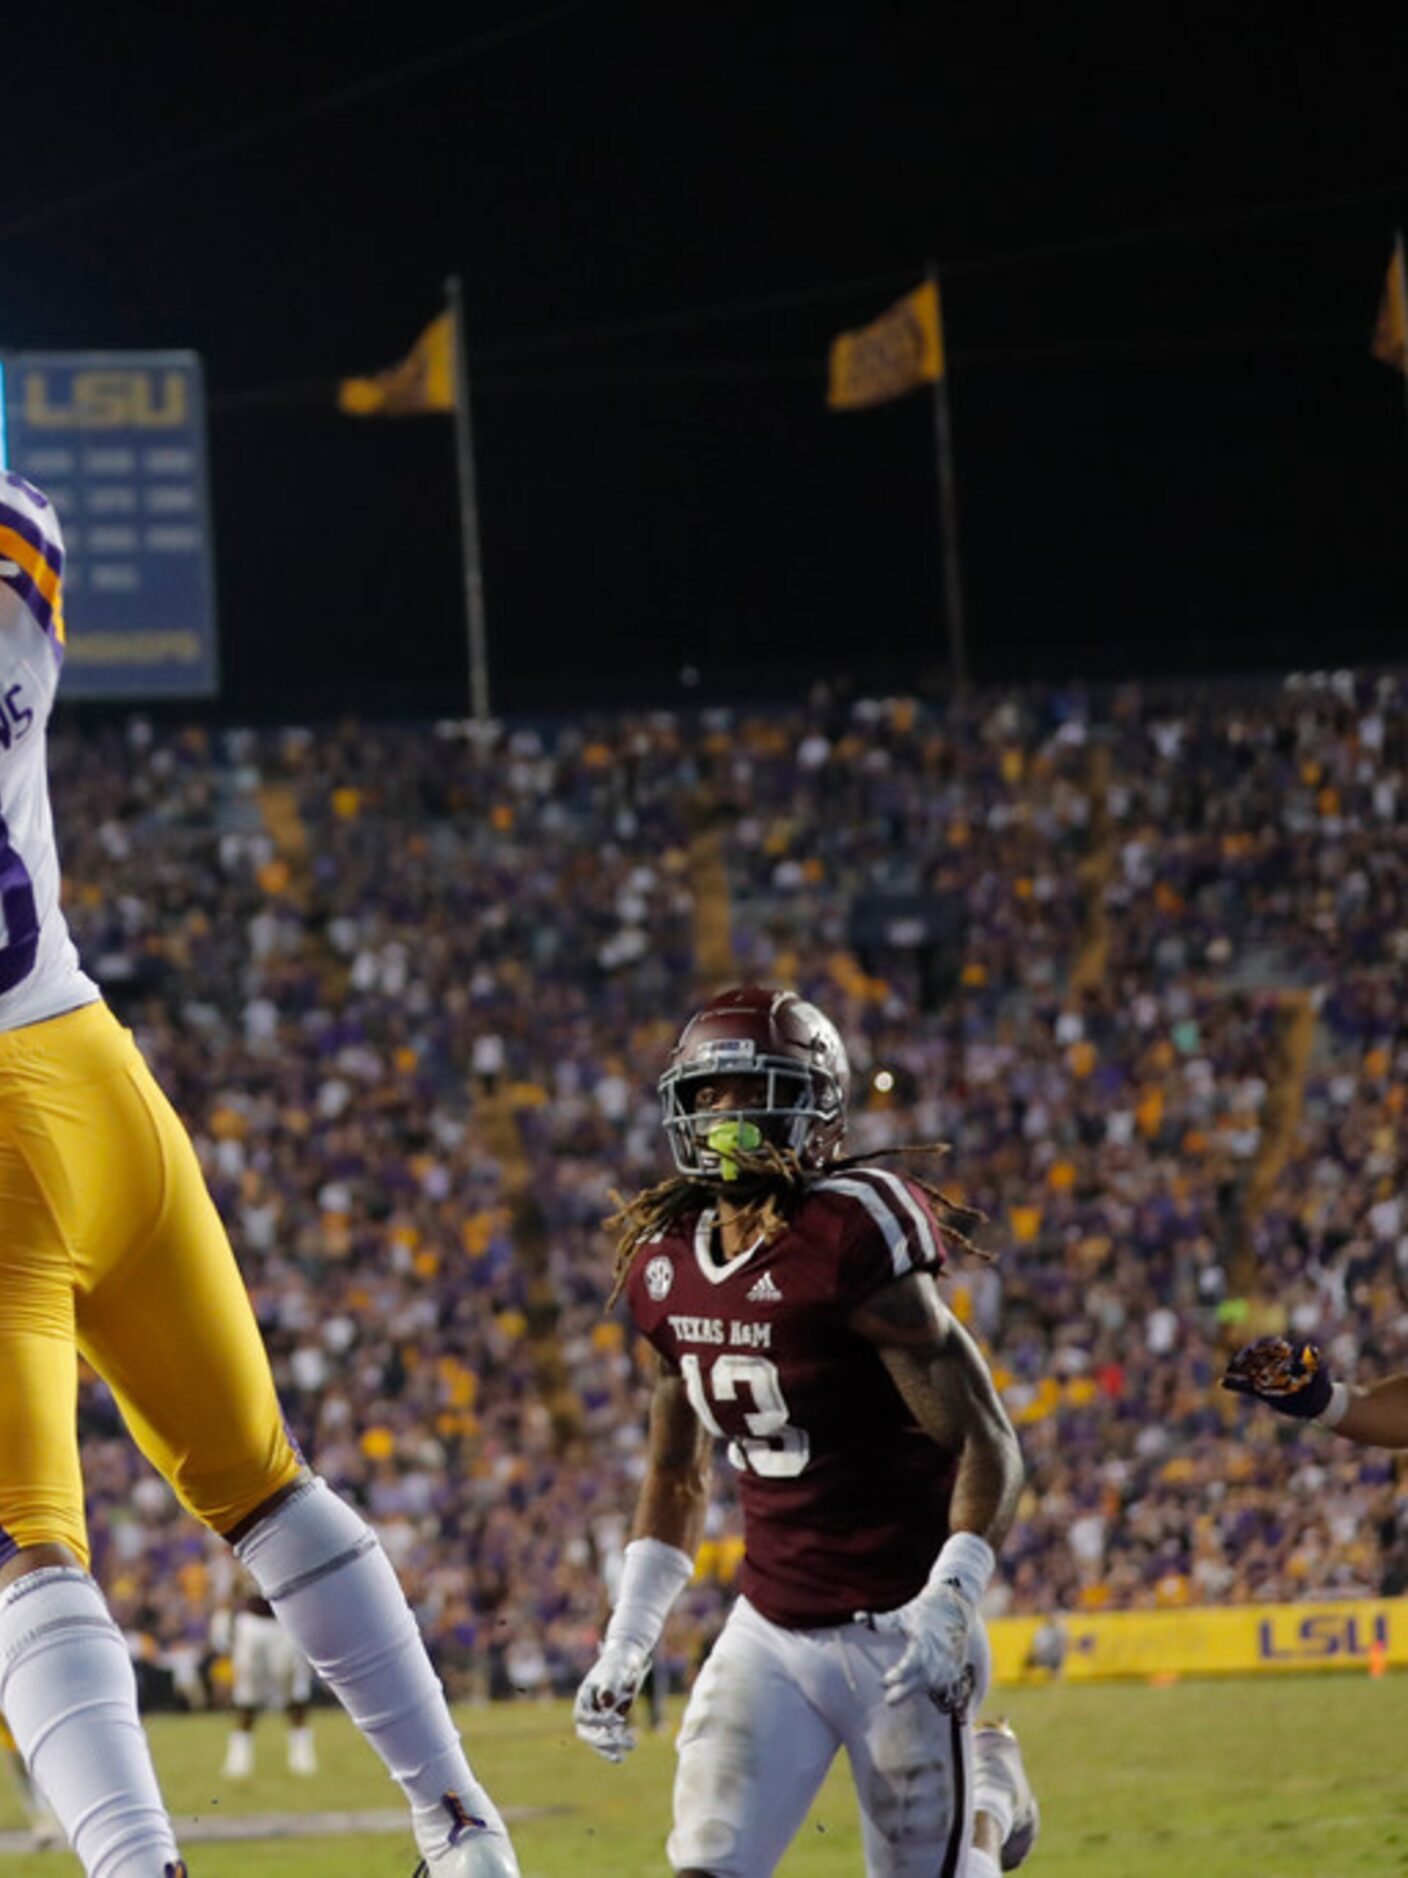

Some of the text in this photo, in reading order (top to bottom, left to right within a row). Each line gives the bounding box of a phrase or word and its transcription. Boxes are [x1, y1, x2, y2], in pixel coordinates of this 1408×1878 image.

[26, 373, 186, 428] LSU
[667, 1314, 773, 1349] TEXAS A&M
[679, 1353, 810, 1478] 13
[1259, 1614, 1388, 1660] LSU
